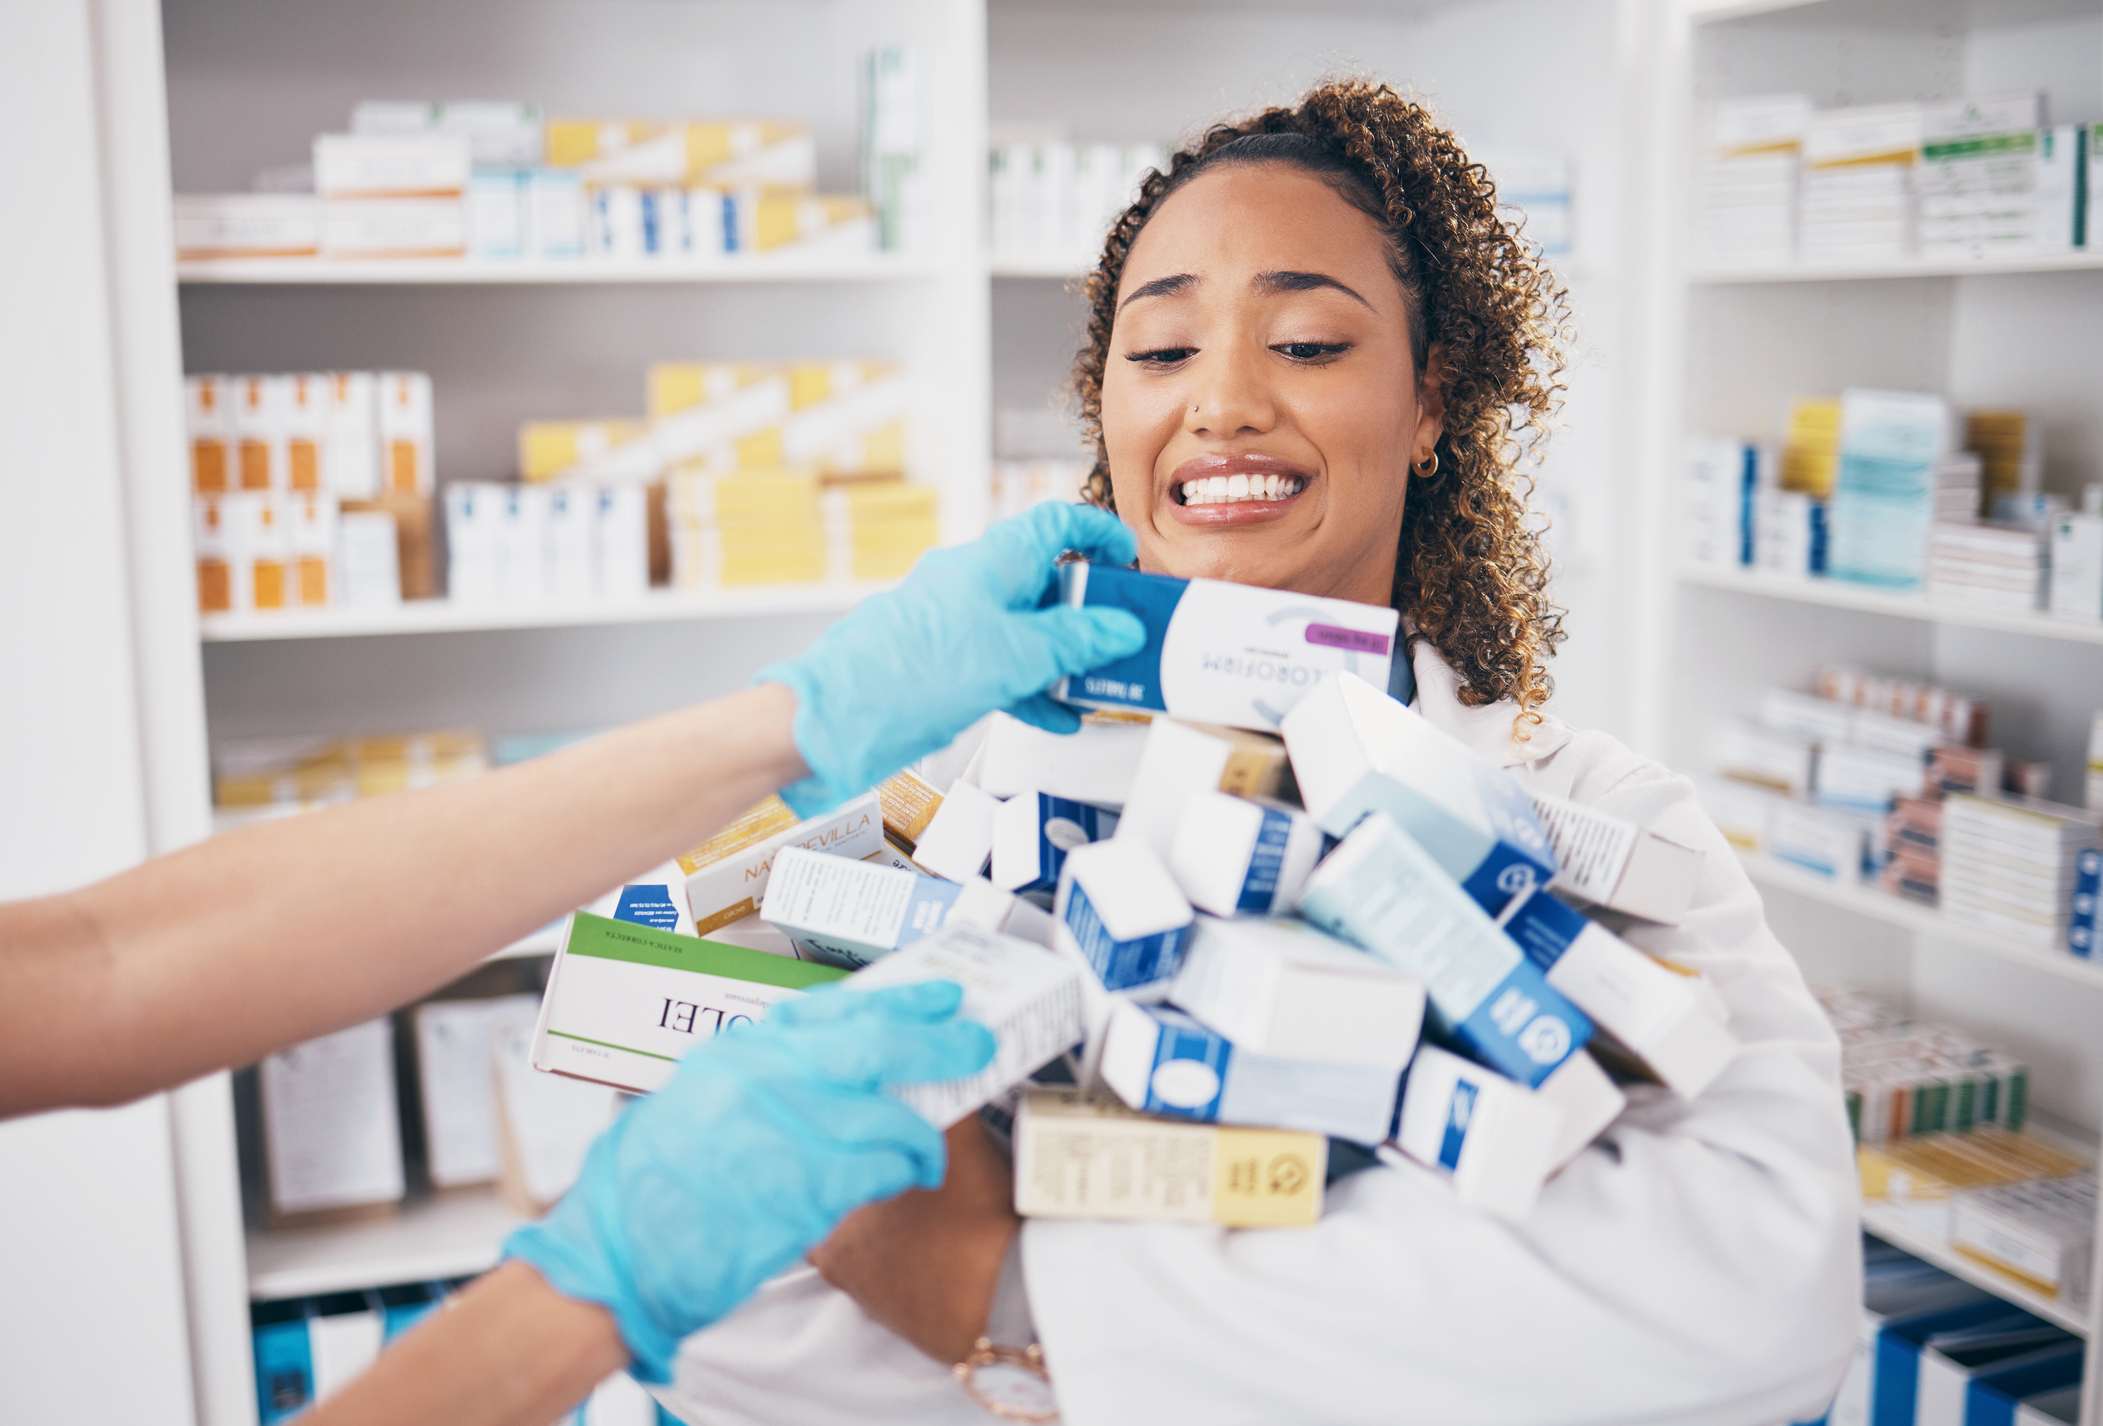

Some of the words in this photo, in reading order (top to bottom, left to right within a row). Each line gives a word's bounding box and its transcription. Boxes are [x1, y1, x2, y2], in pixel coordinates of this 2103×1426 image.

[1202, 653, 1326, 687] LOROFIRM
[1084, 677, 1128, 699] TABLETS
[1127, 682, 1145, 701] 30
[742, 813, 870, 882] NAEVILLA
[722, 905, 745, 919] aloe
[604, 929, 647, 945] CORRECTA
[658, 998, 754, 1040] OLEI
